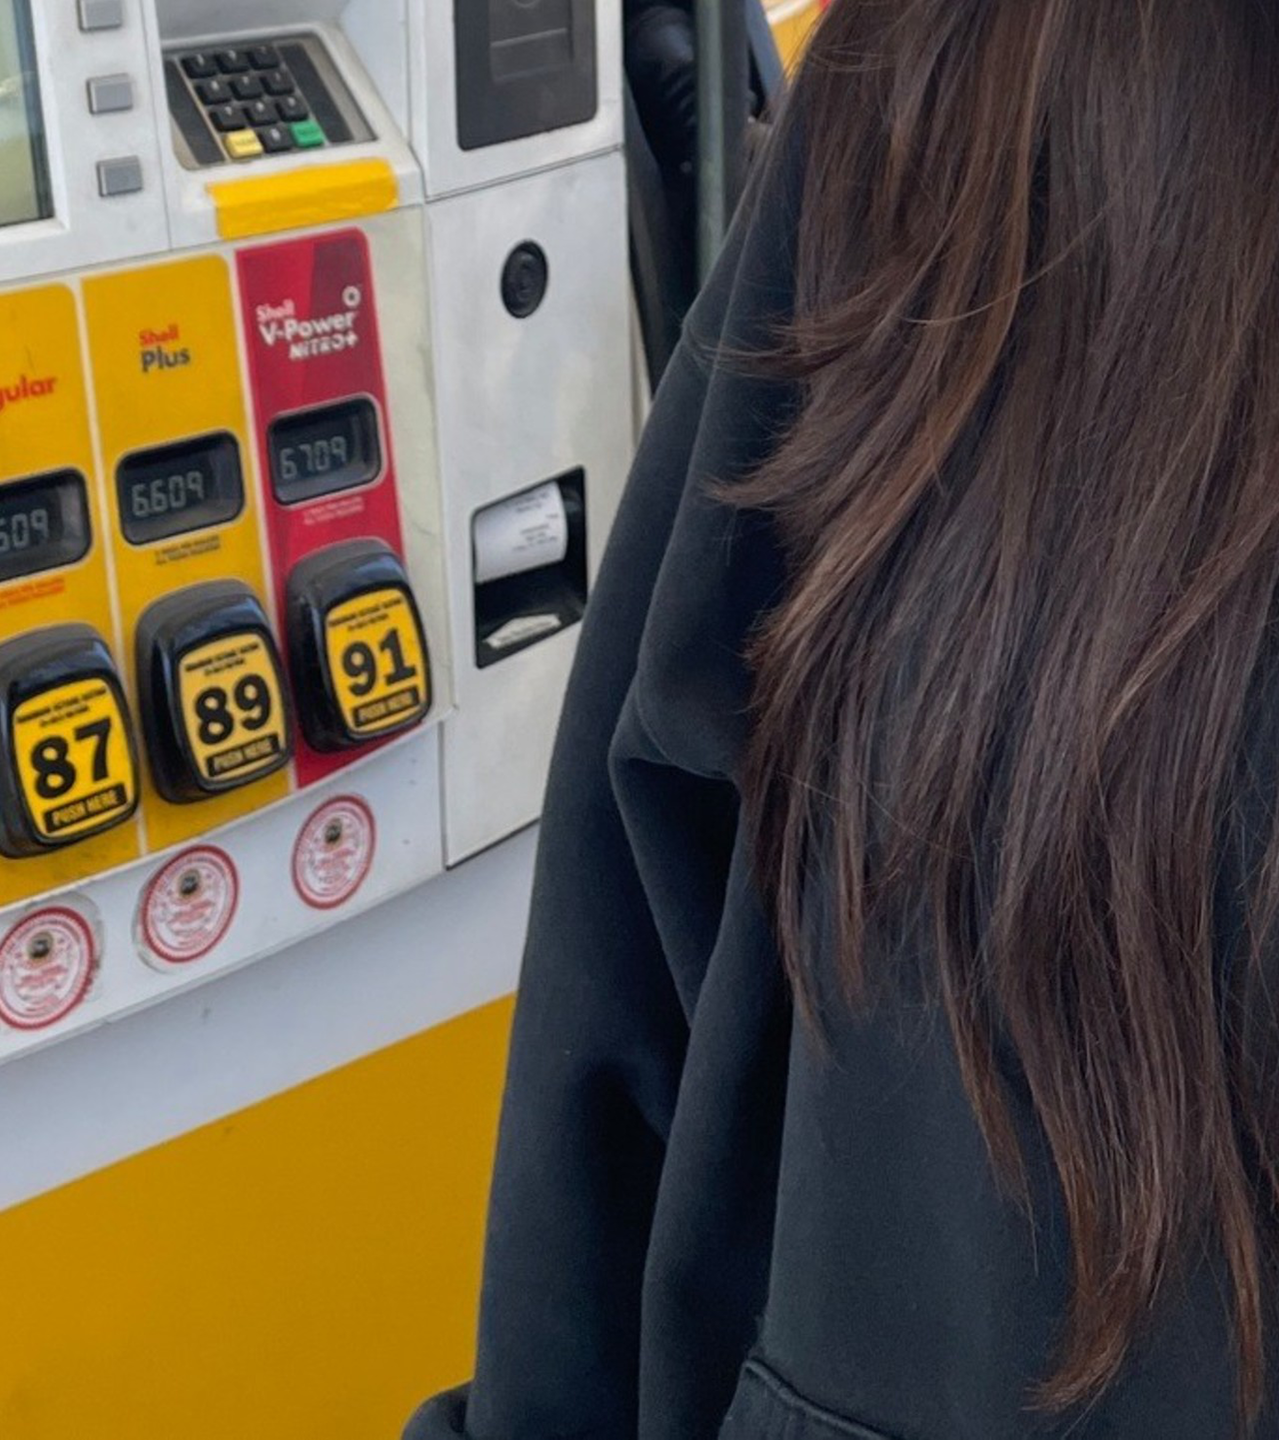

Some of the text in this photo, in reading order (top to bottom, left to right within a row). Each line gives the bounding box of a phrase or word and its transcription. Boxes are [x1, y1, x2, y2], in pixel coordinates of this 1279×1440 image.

[256, 299, 294, 323] Shell
[259, 311, 357, 346] V-Power
[139, 325, 179, 347] Shell
[140, 347, 190, 373] Plus
[342, 628, 416, 696] 91
[195, 673, 271, 744] 89
[31, 717, 111, 798] 87
